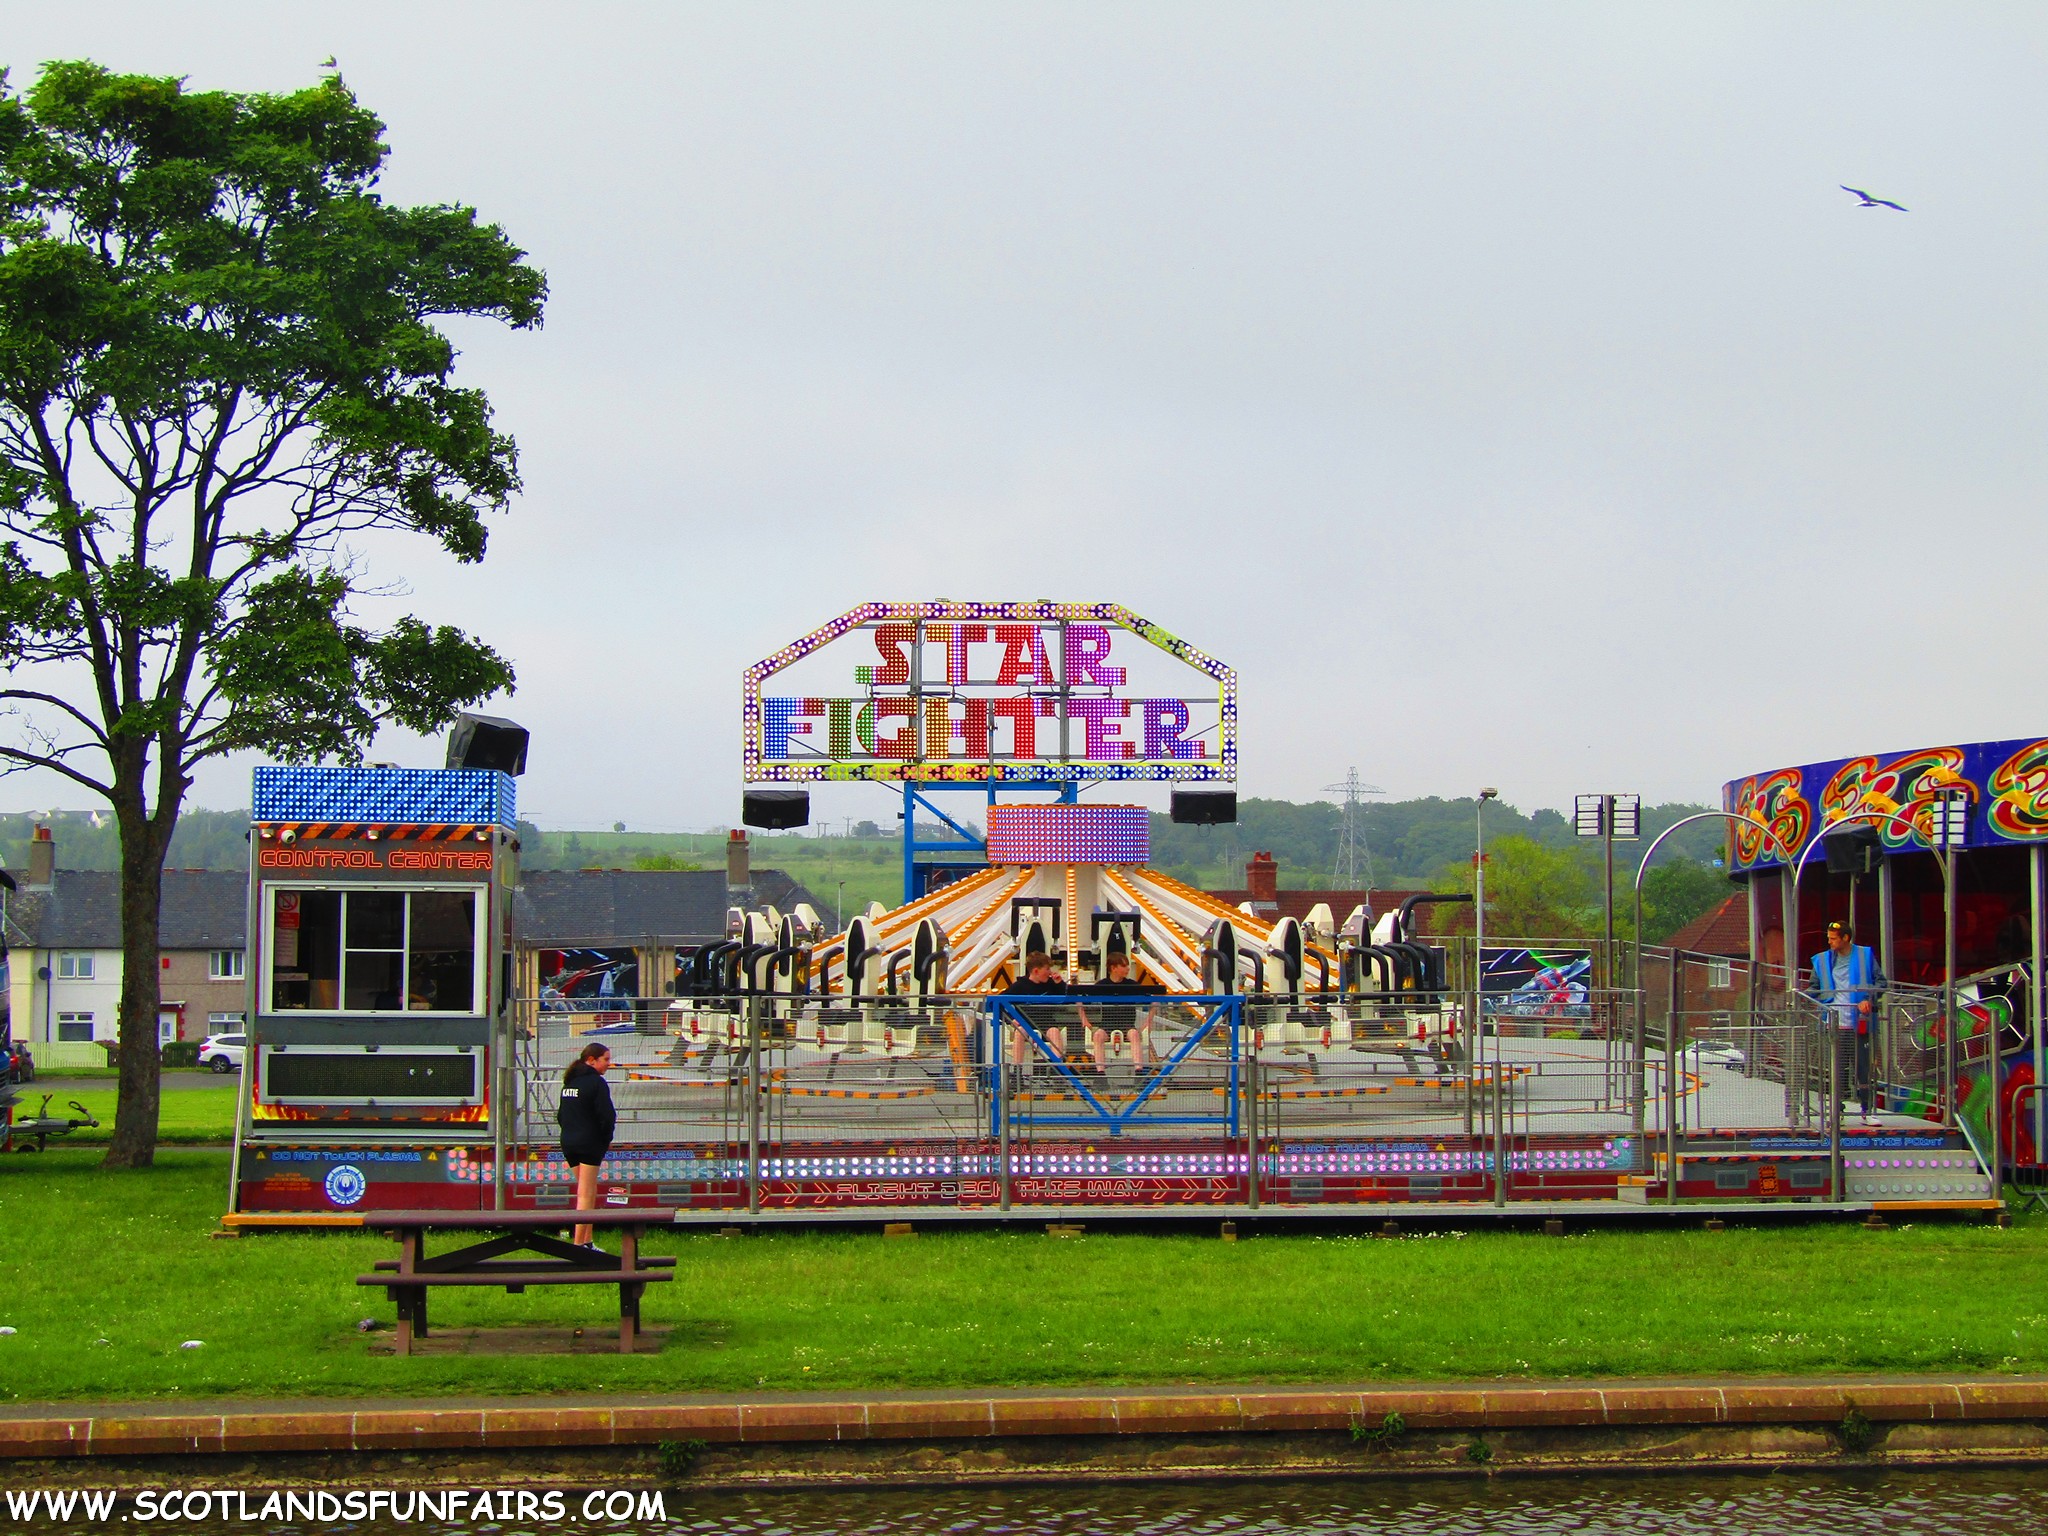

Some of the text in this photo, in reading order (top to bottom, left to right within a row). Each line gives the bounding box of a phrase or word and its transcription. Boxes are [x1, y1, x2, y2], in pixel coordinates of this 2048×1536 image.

[855, 623, 1127, 686] STAR
[764, 697, 1206, 760] FIGHTER
[260, 850, 492, 870] CONTROL CENTER
[562, 1088, 578, 1097] KATIE
[1285, 1142, 1429, 1153] DO NOT TOUCH PLASMA
[1873, 1137, 1903, 1147] THIS
[1904, 1137, 1944, 1147] POINT
[271, 1151, 422, 1162] DO NOT TOUCH PLASMA
[836, 1182, 935, 1200] FLIGHT
[1014, 1180, 1081, 1198] THIS
[1087, 1180, 1145, 1198] WAY
